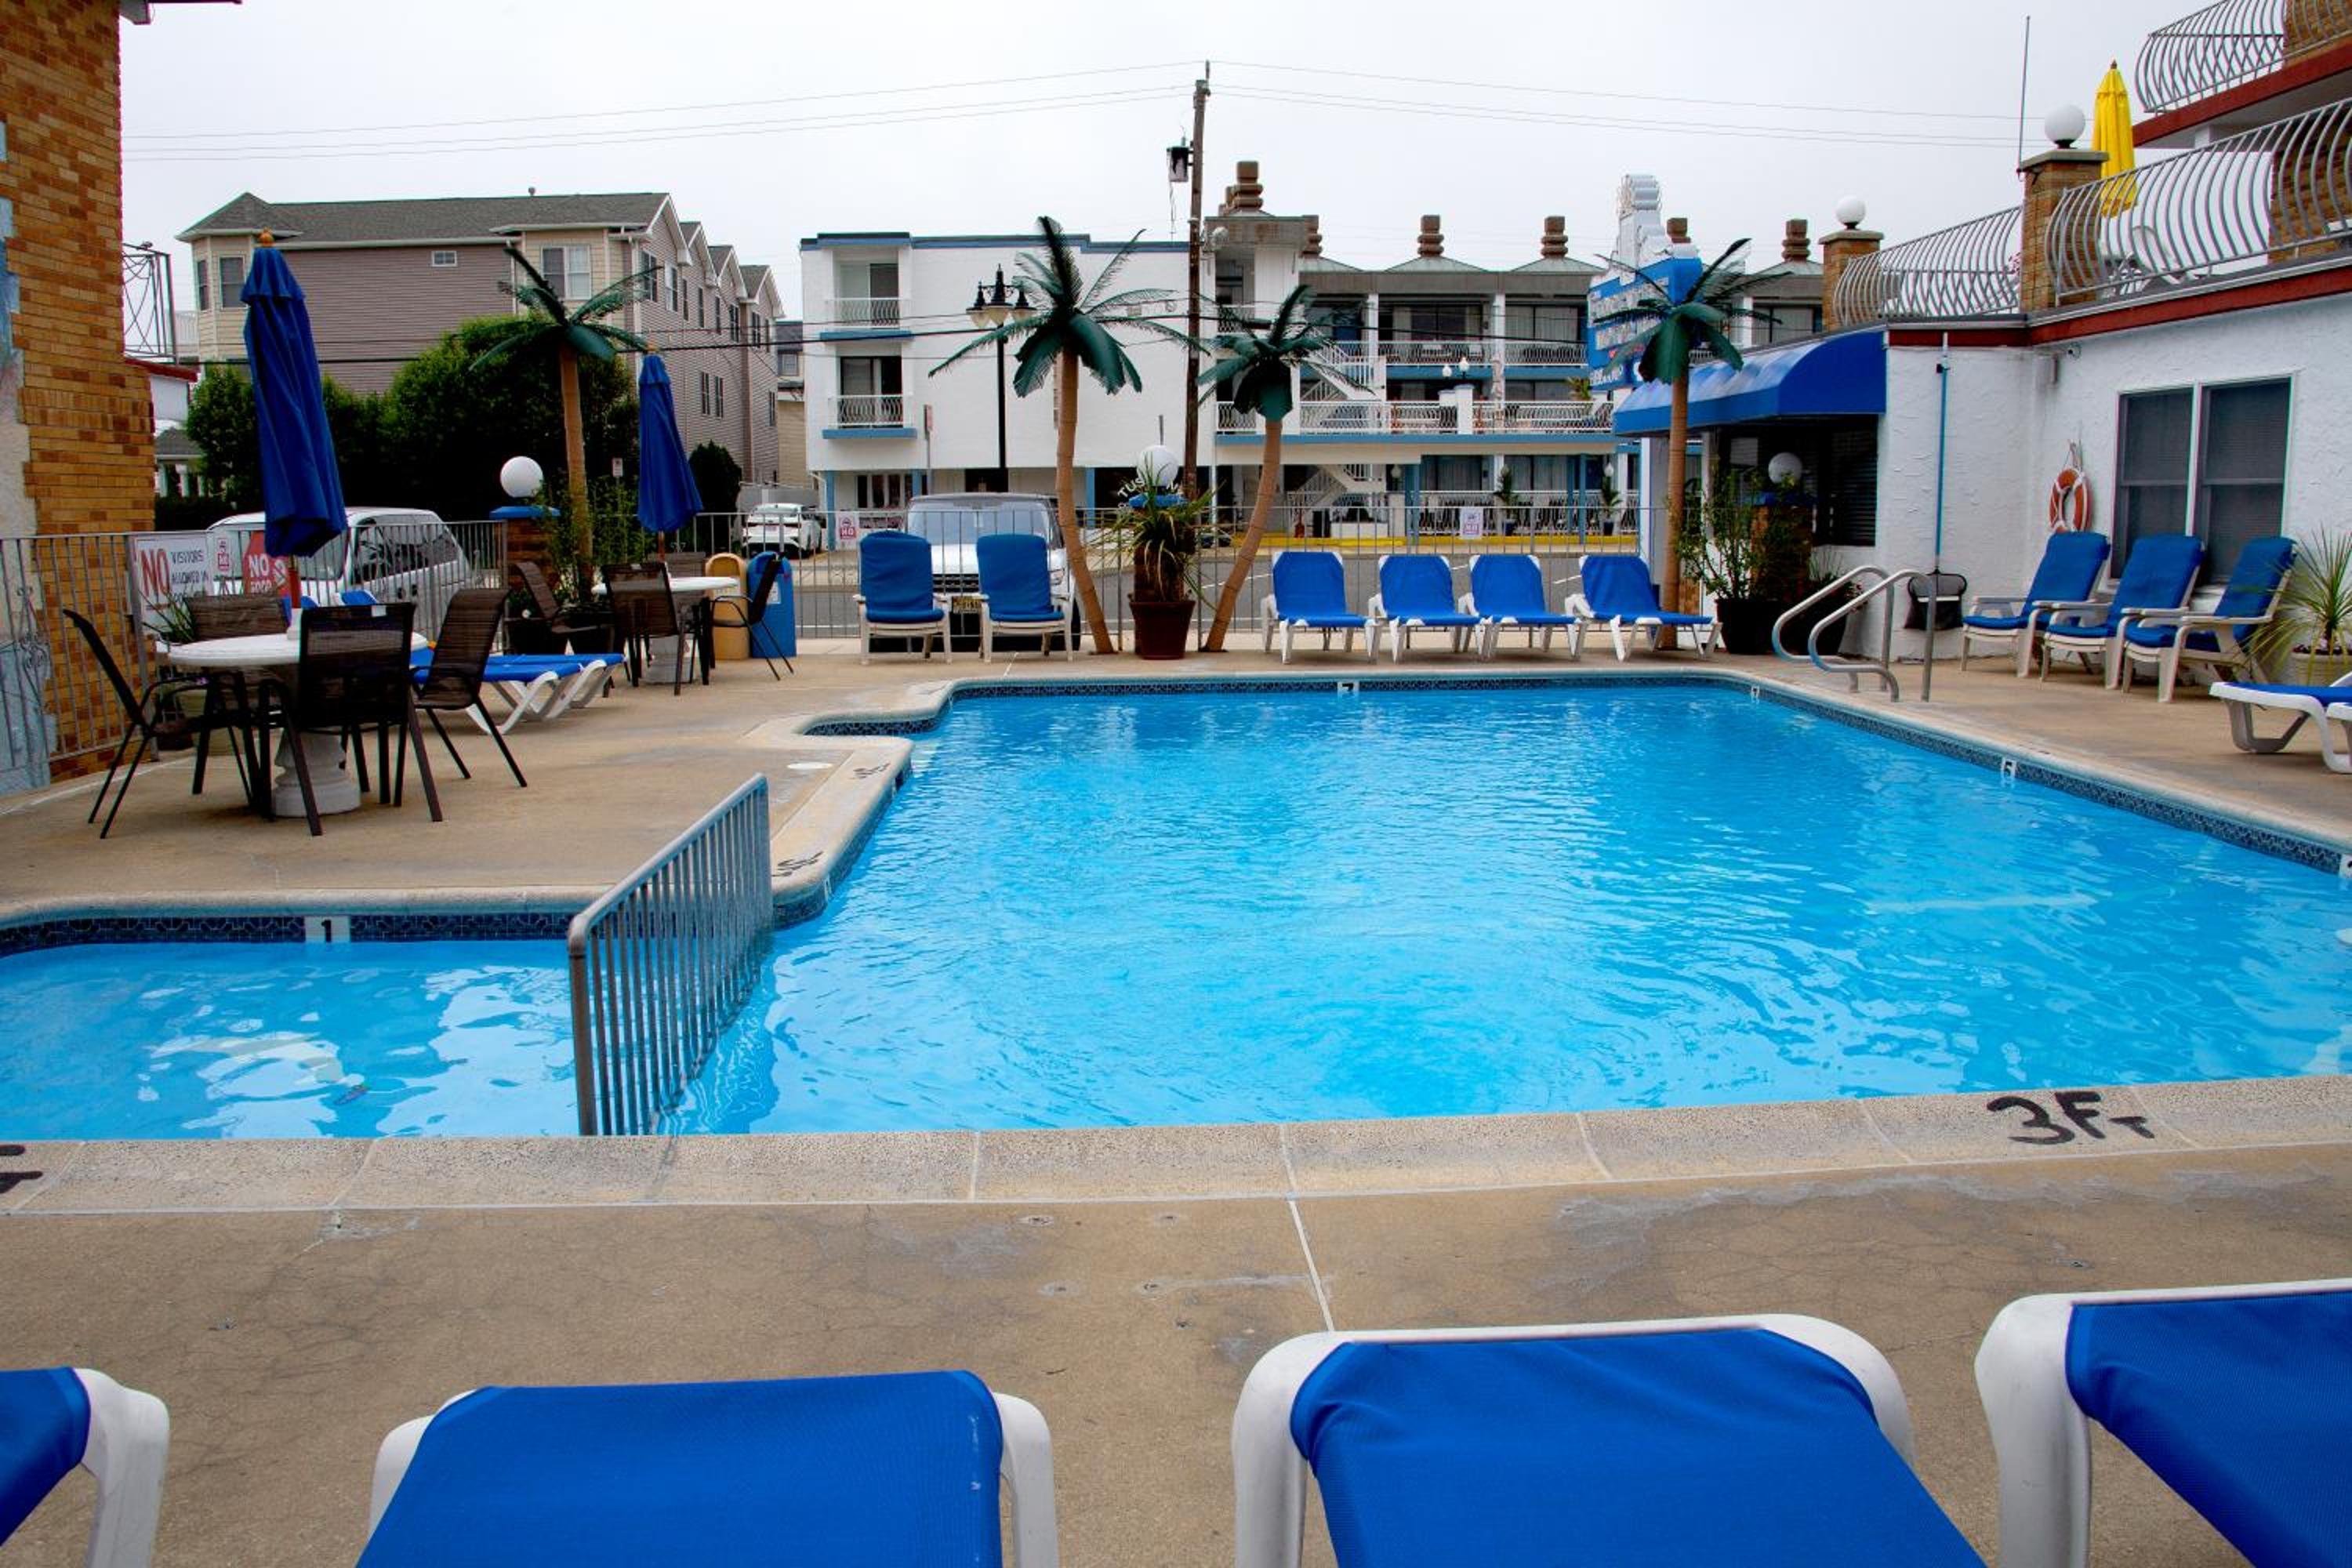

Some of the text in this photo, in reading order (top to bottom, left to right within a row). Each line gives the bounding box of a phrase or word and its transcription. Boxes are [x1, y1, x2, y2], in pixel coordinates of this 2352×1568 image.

[171, 550, 204, 564] VISITORS
[249, 554, 270, 578] NO
[140, 549, 171, 601] NO
[2004, 760, 2013, 776] 5
[321, 919, 332, 942] 1
